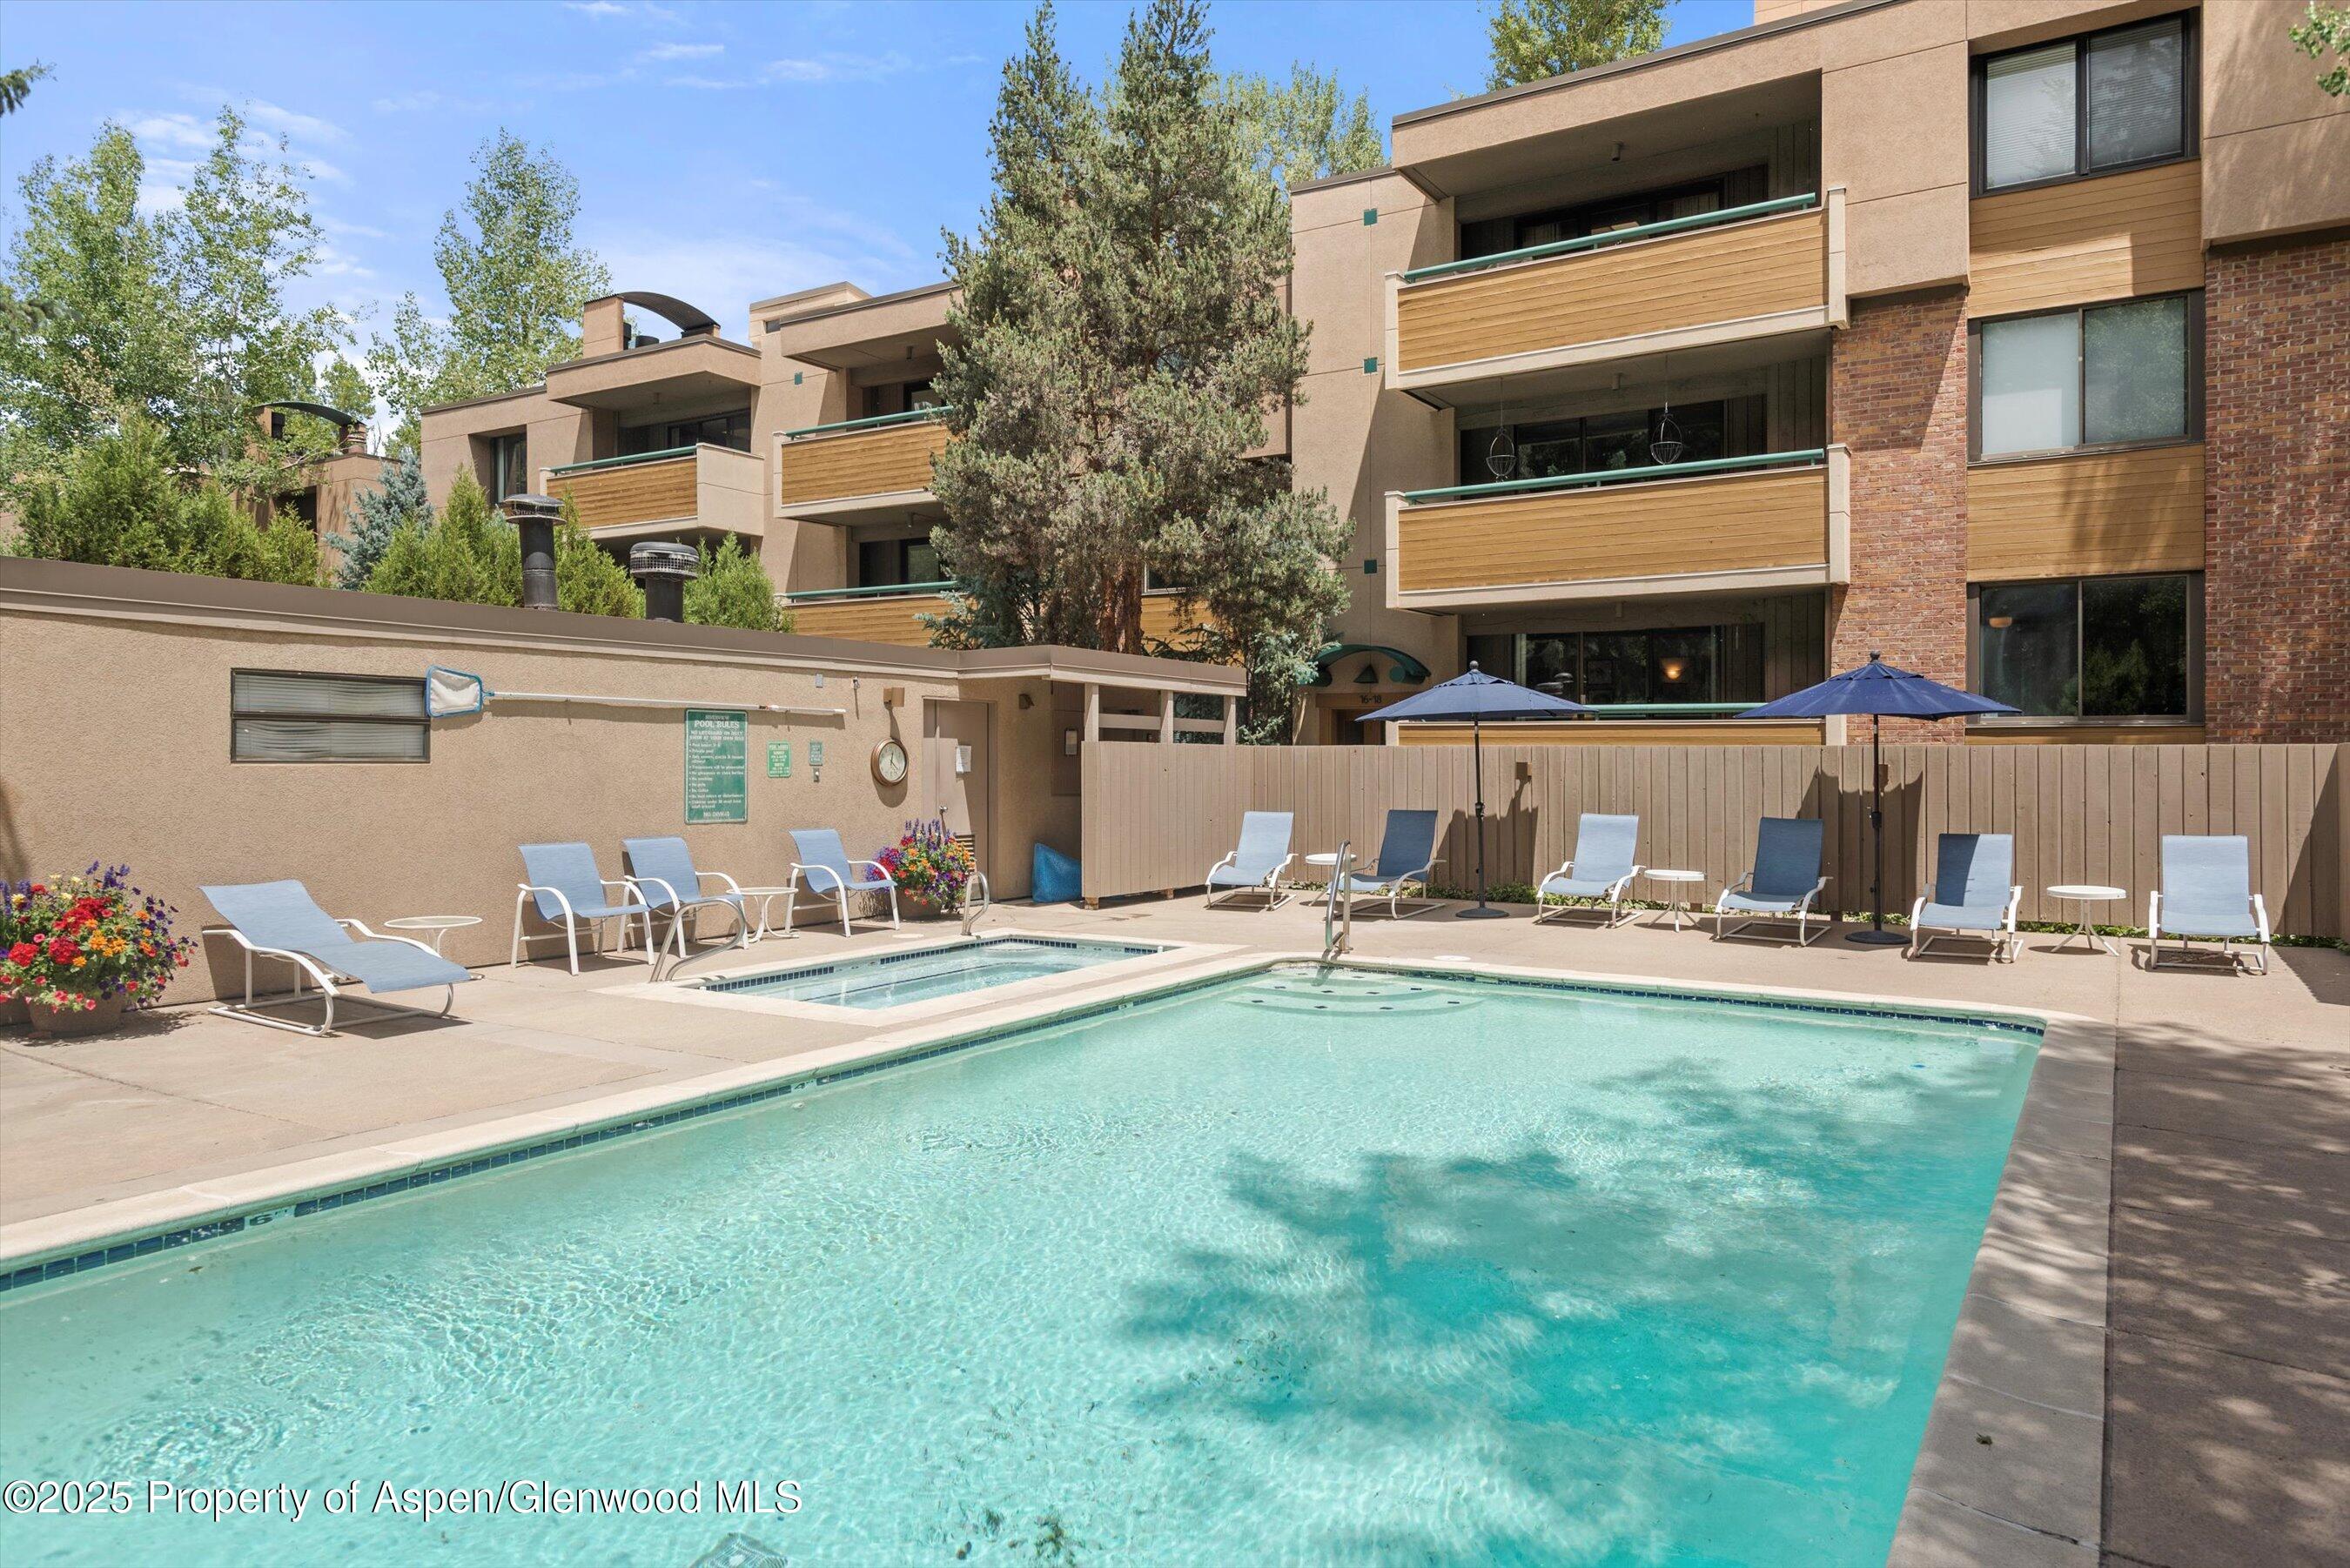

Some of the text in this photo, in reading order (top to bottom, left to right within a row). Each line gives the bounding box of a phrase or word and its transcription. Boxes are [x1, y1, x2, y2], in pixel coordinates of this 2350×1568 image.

[1360, 694, 1382, 704] 16-18
[694, 720, 740, 729] POOL RULES
[249, 1213, 273, 1226] 6
